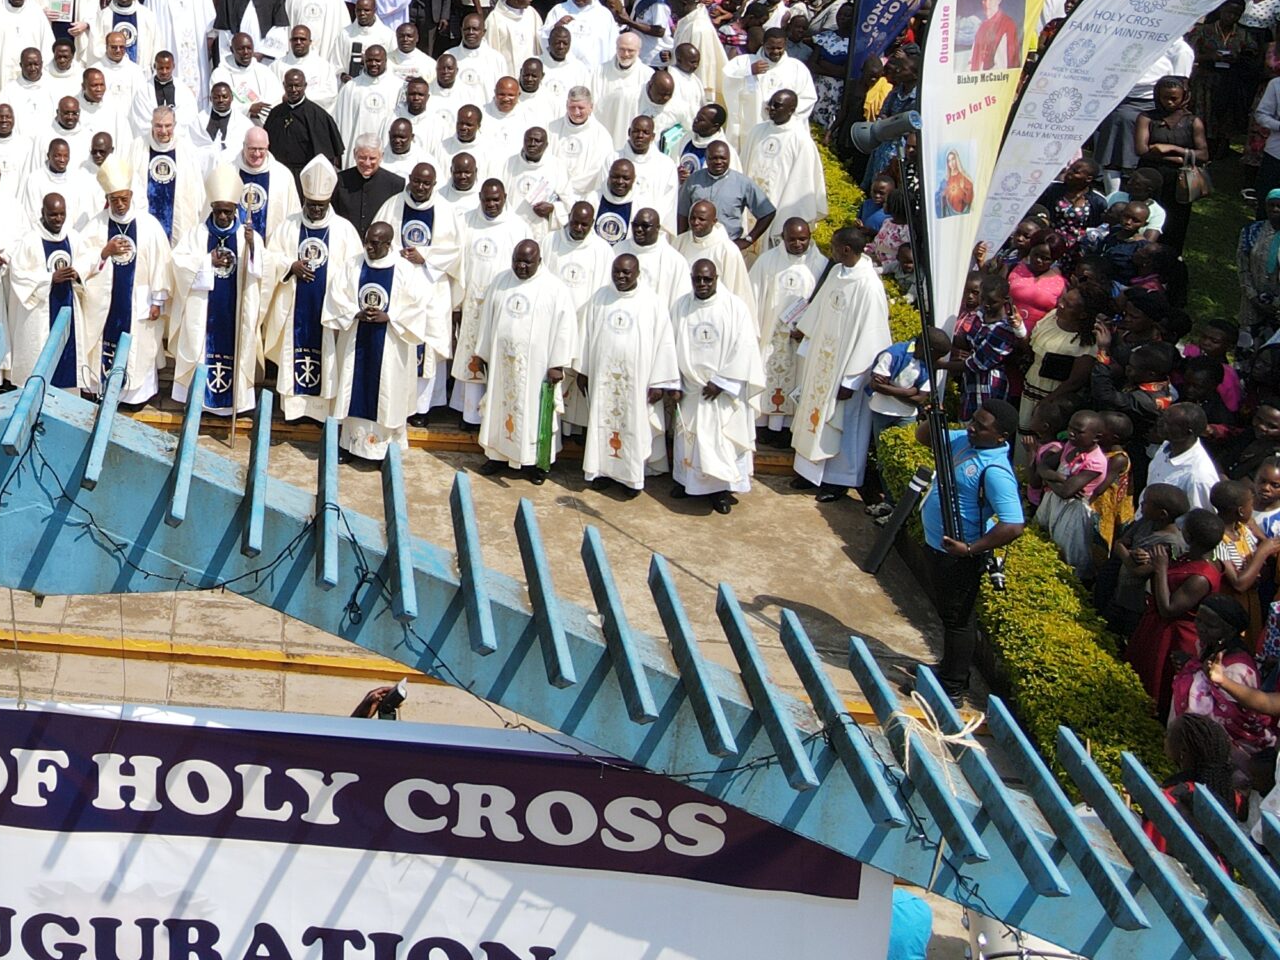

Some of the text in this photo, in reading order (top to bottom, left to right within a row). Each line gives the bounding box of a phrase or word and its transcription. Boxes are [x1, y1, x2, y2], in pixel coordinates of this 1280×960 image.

[1094, 10, 1164, 28] HOLY CROSS
[938, 6, 950, 64] Otusabire
[1069, 20, 1170, 42] FAMILY MINISTRIES
[957, 72, 1010, 85] Bishop McCauley
[945, 94, 997, 124] Pray for Us
[1011, 130, 1083, 140] FAMILY MINISTRIES
[1027, 122, 1075, 132] HOLY CROSS
[92, 752, 360, 825] HOLY
[383, 777, 728, 857] CROSS
